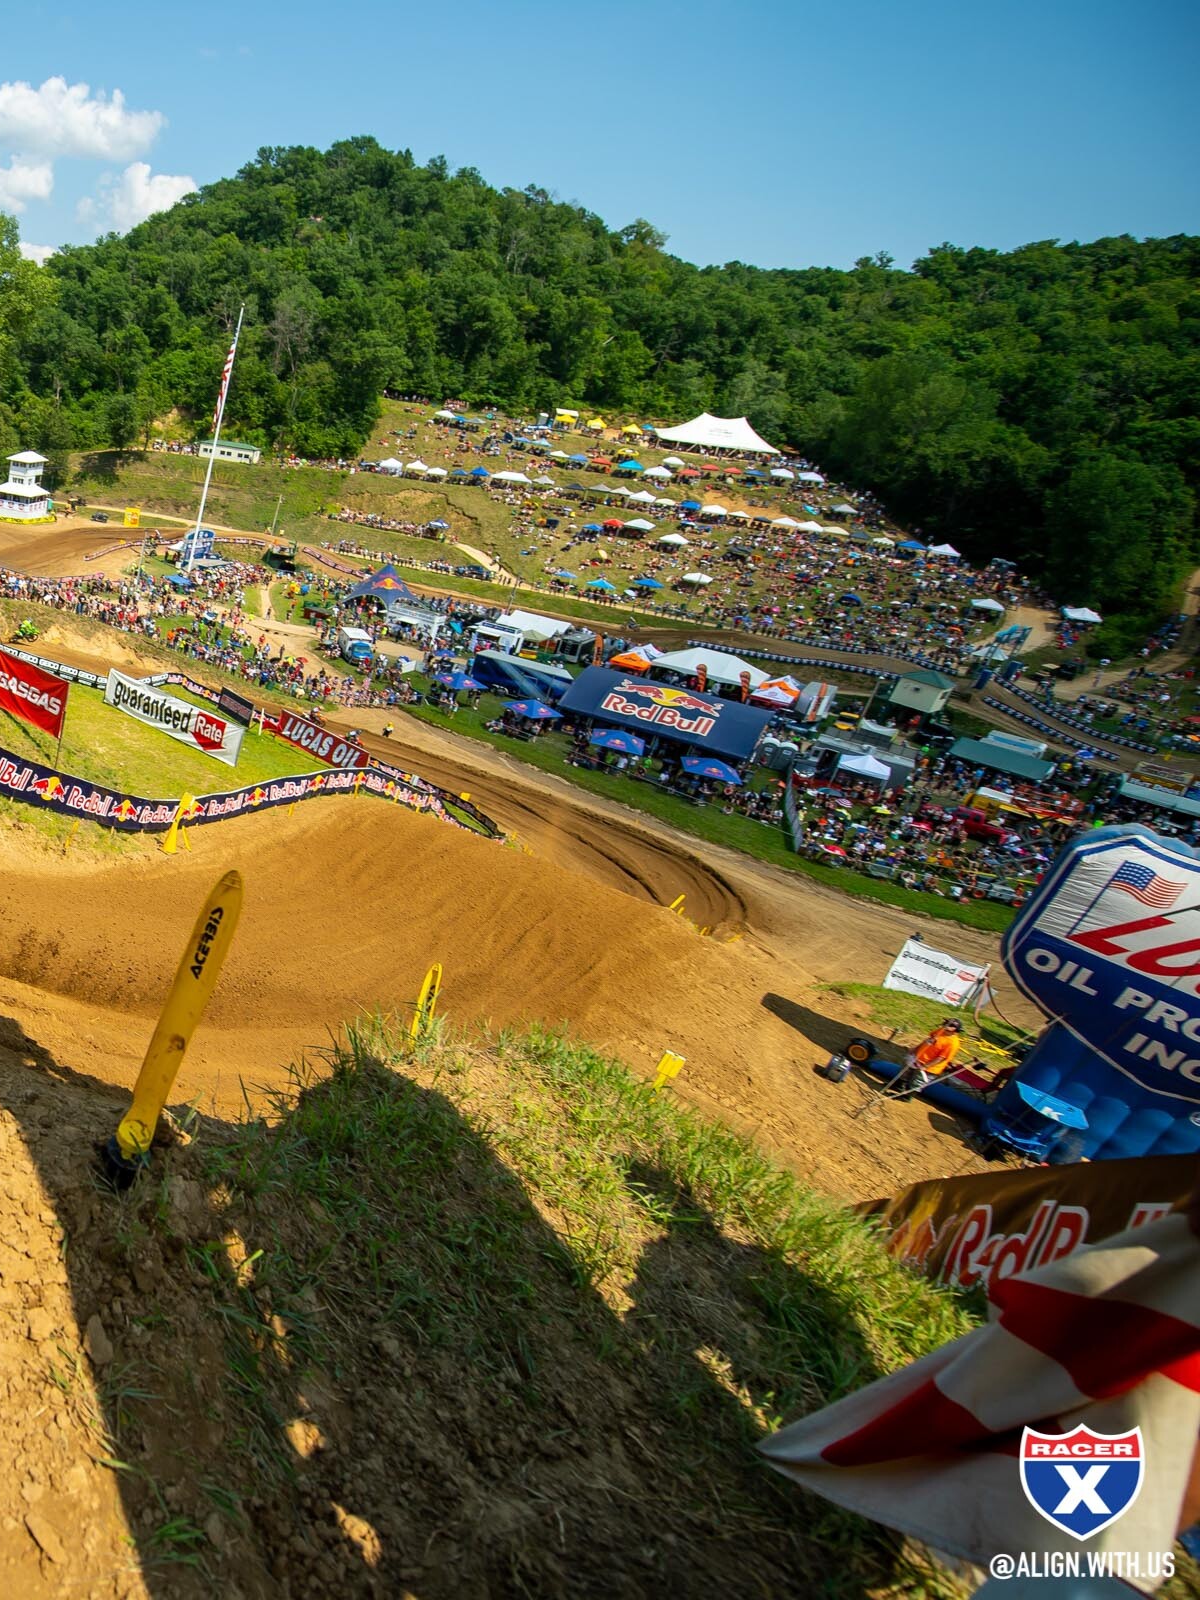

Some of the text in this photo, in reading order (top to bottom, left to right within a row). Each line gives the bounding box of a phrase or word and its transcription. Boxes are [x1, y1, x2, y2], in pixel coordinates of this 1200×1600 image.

[113, 681, 194, 734] guaranteed
[195, 715, 222, 743] Rate
[601, 693, 716, 737] Red Bull
[282, 717, 361, 768] LUCAS OIL
[0, 761, 33, 791] Bull
[66, 786, 114, 817] Red Bull
[1025, 948, 1098, 996] OIL
